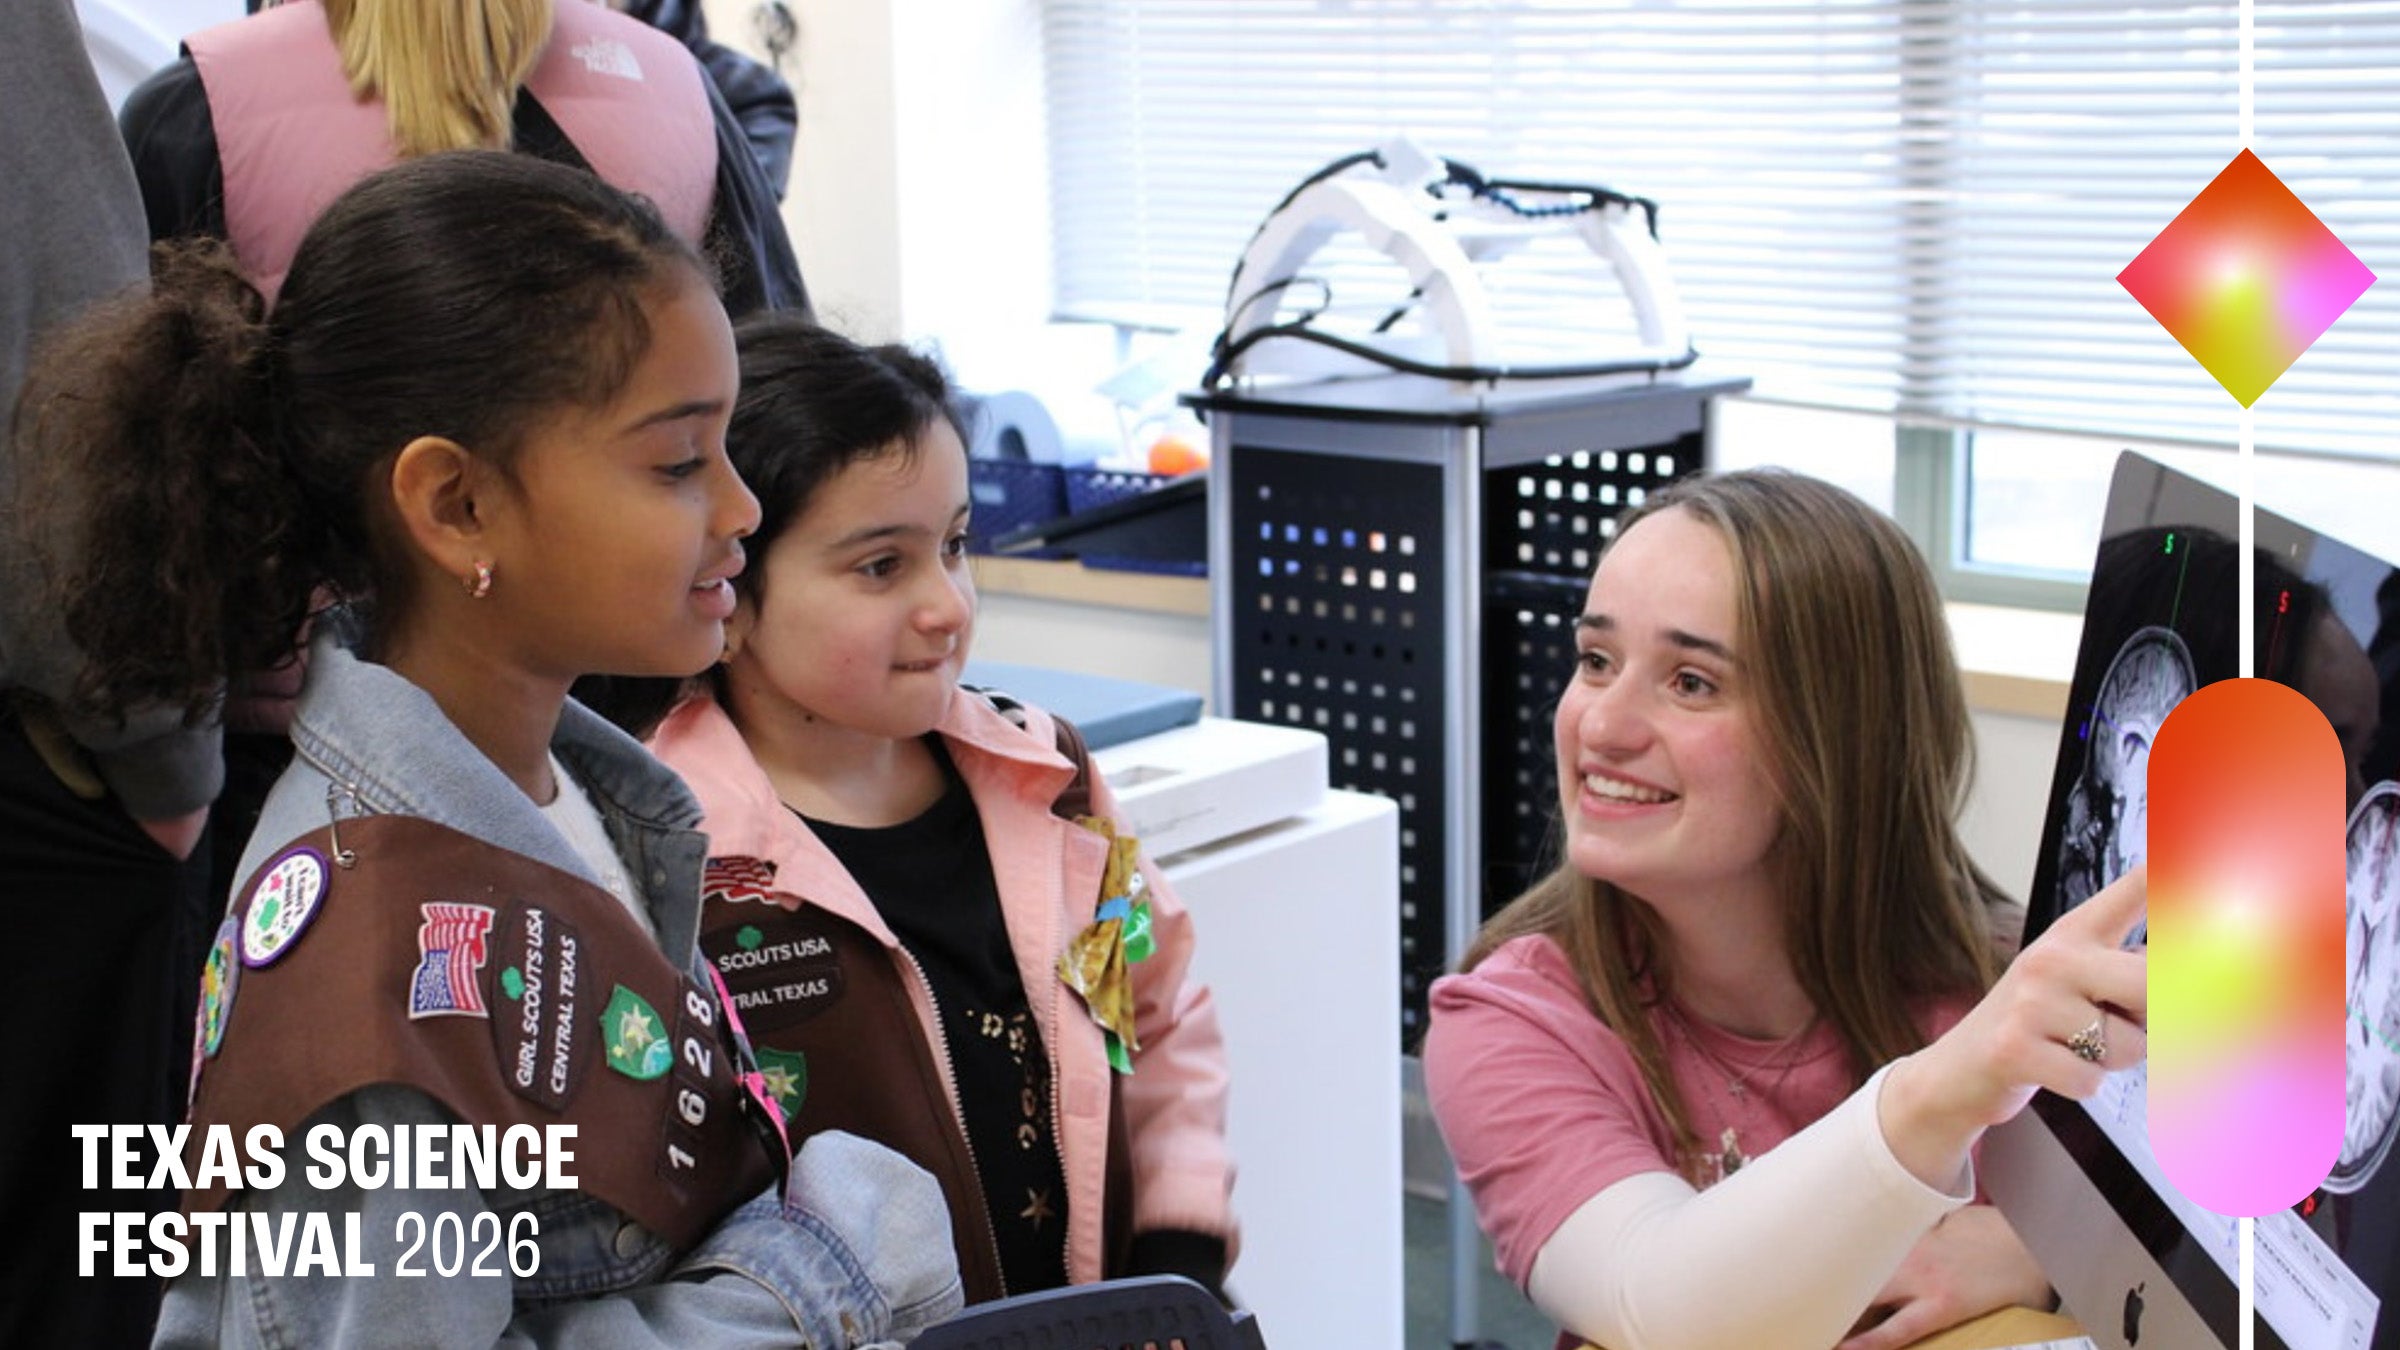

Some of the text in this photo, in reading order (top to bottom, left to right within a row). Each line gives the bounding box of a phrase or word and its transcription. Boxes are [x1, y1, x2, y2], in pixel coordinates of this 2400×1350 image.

[516, 908, 544, 1087] GIRL SCOUTS USA
[718, 937, 831, 973] SCOUTS USA
[731, 979, 829, 1010] TRAL TEXAS
[551, 934, 577, 1094] CENTRAL TEXAS
